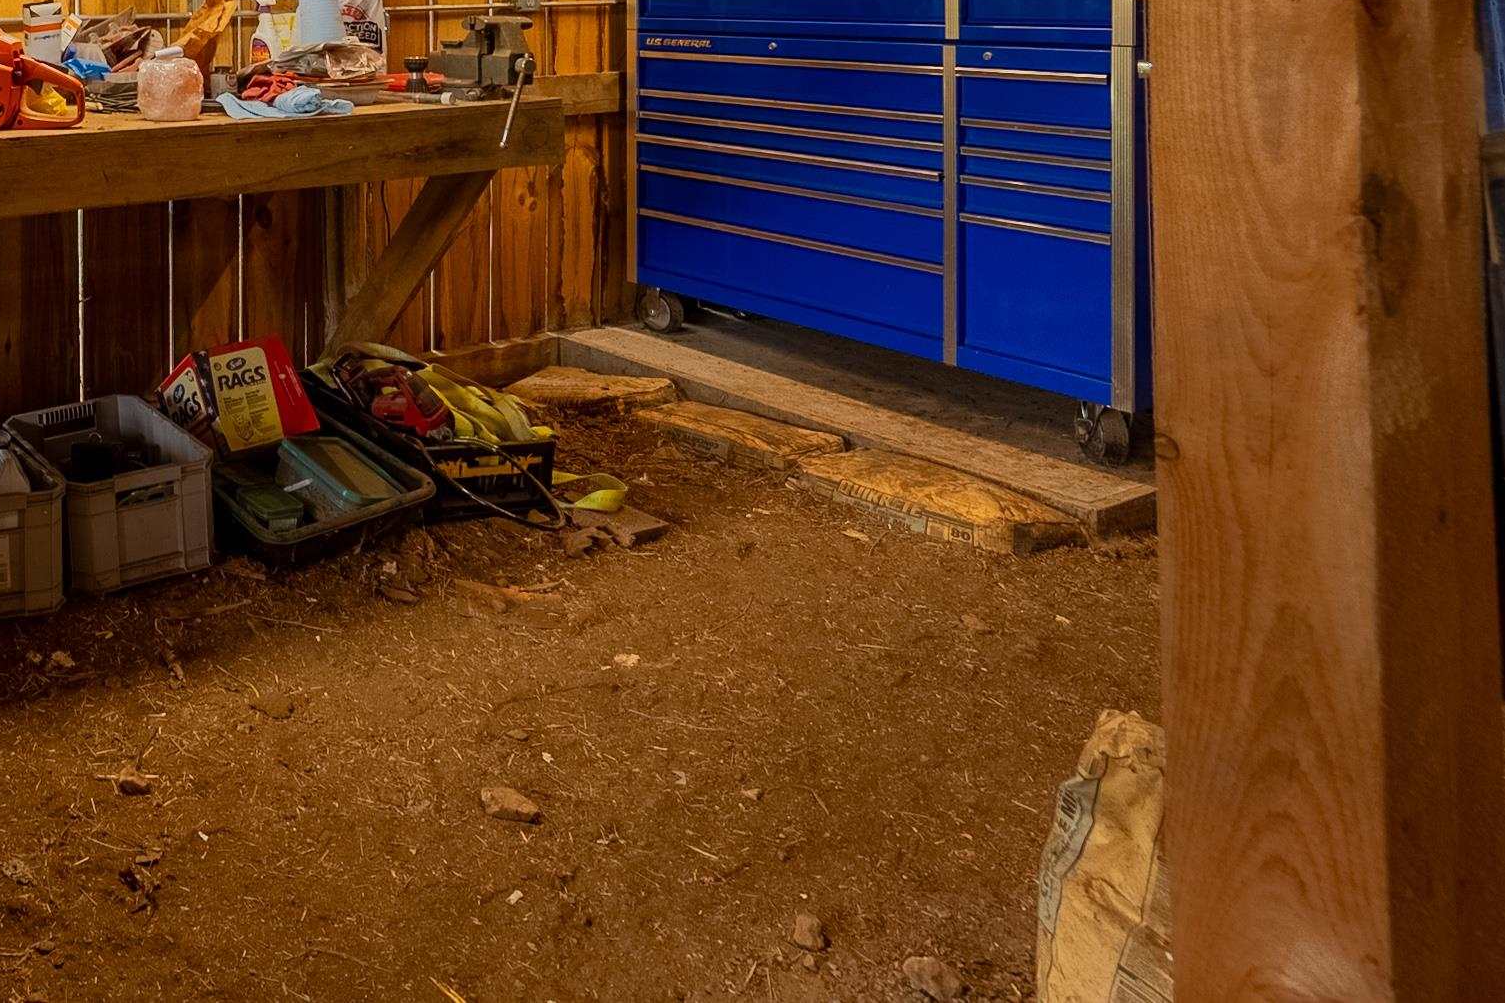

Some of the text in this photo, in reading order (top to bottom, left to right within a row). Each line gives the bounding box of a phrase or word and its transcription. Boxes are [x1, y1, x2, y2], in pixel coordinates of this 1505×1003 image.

[663, 39, 712, 48] GENERAL
[217, 365, 266, 391] RAGS
[951, 527, 971, 541] 80
